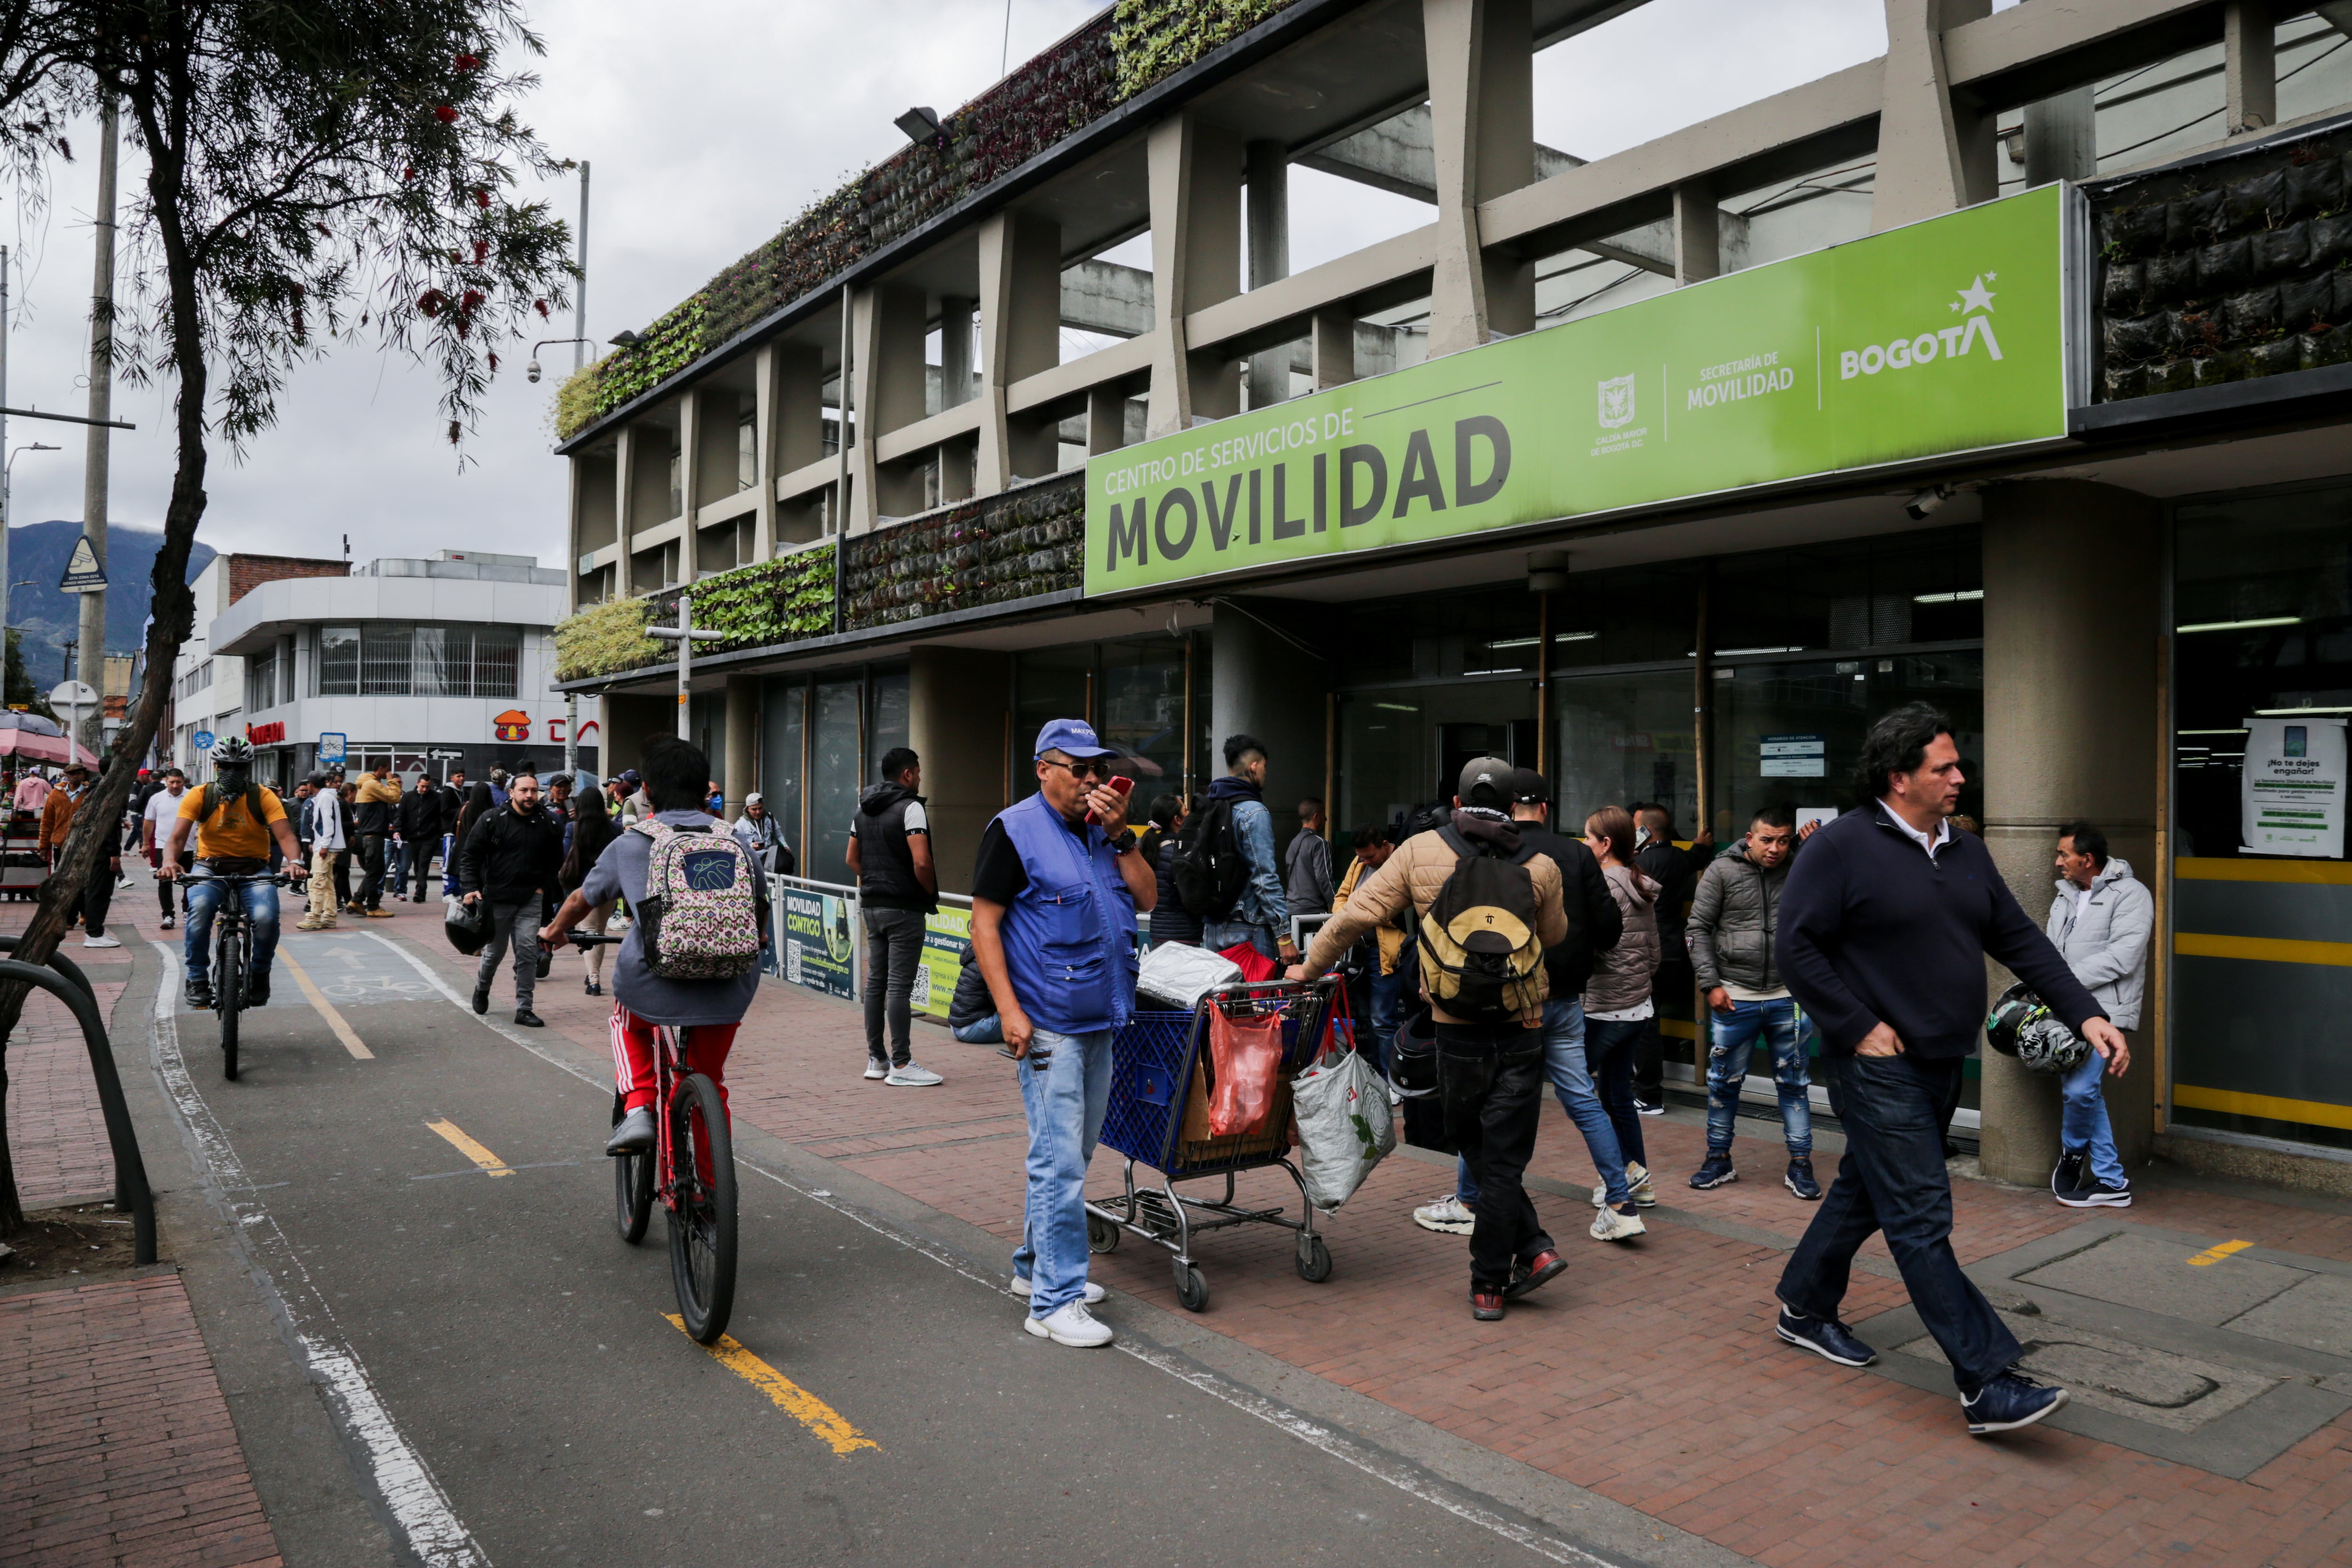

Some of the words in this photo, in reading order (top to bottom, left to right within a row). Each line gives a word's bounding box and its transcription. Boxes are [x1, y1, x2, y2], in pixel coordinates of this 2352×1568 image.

[1700, 354, 1762, 381] SECRETARÍA
[1764, 351, 1778, 366] DE
[1688, 367, 1794, 410] MOVILIDAD
[1623, 427, 1647, 439] MAYOR
[1105, 456, 1176, 495] CENTRO
[1181, 447, 1205, 476] DE
[1211, 418, 1317, 469] SERVICIOS
[1324, 408, 1353, 440] DE
[1591, 448, 1600, 456] DE
[1601, 440, 1629, 454] BOGOTÁ
[1631, 439, 1644, 448] D.C.
[1106, 415, 1511, 572] MOVILIDAD
[2296, 760, 2320, 768] dejes
[787, 896, 821, 916] MOVILIDAD
[787, 914, 820, 937] CONTIGO
[925, 913, 964, 932] VILIDAD
[934, 937, 958, 948] gestionar
[931, 969, 946, 979] Ingresa
